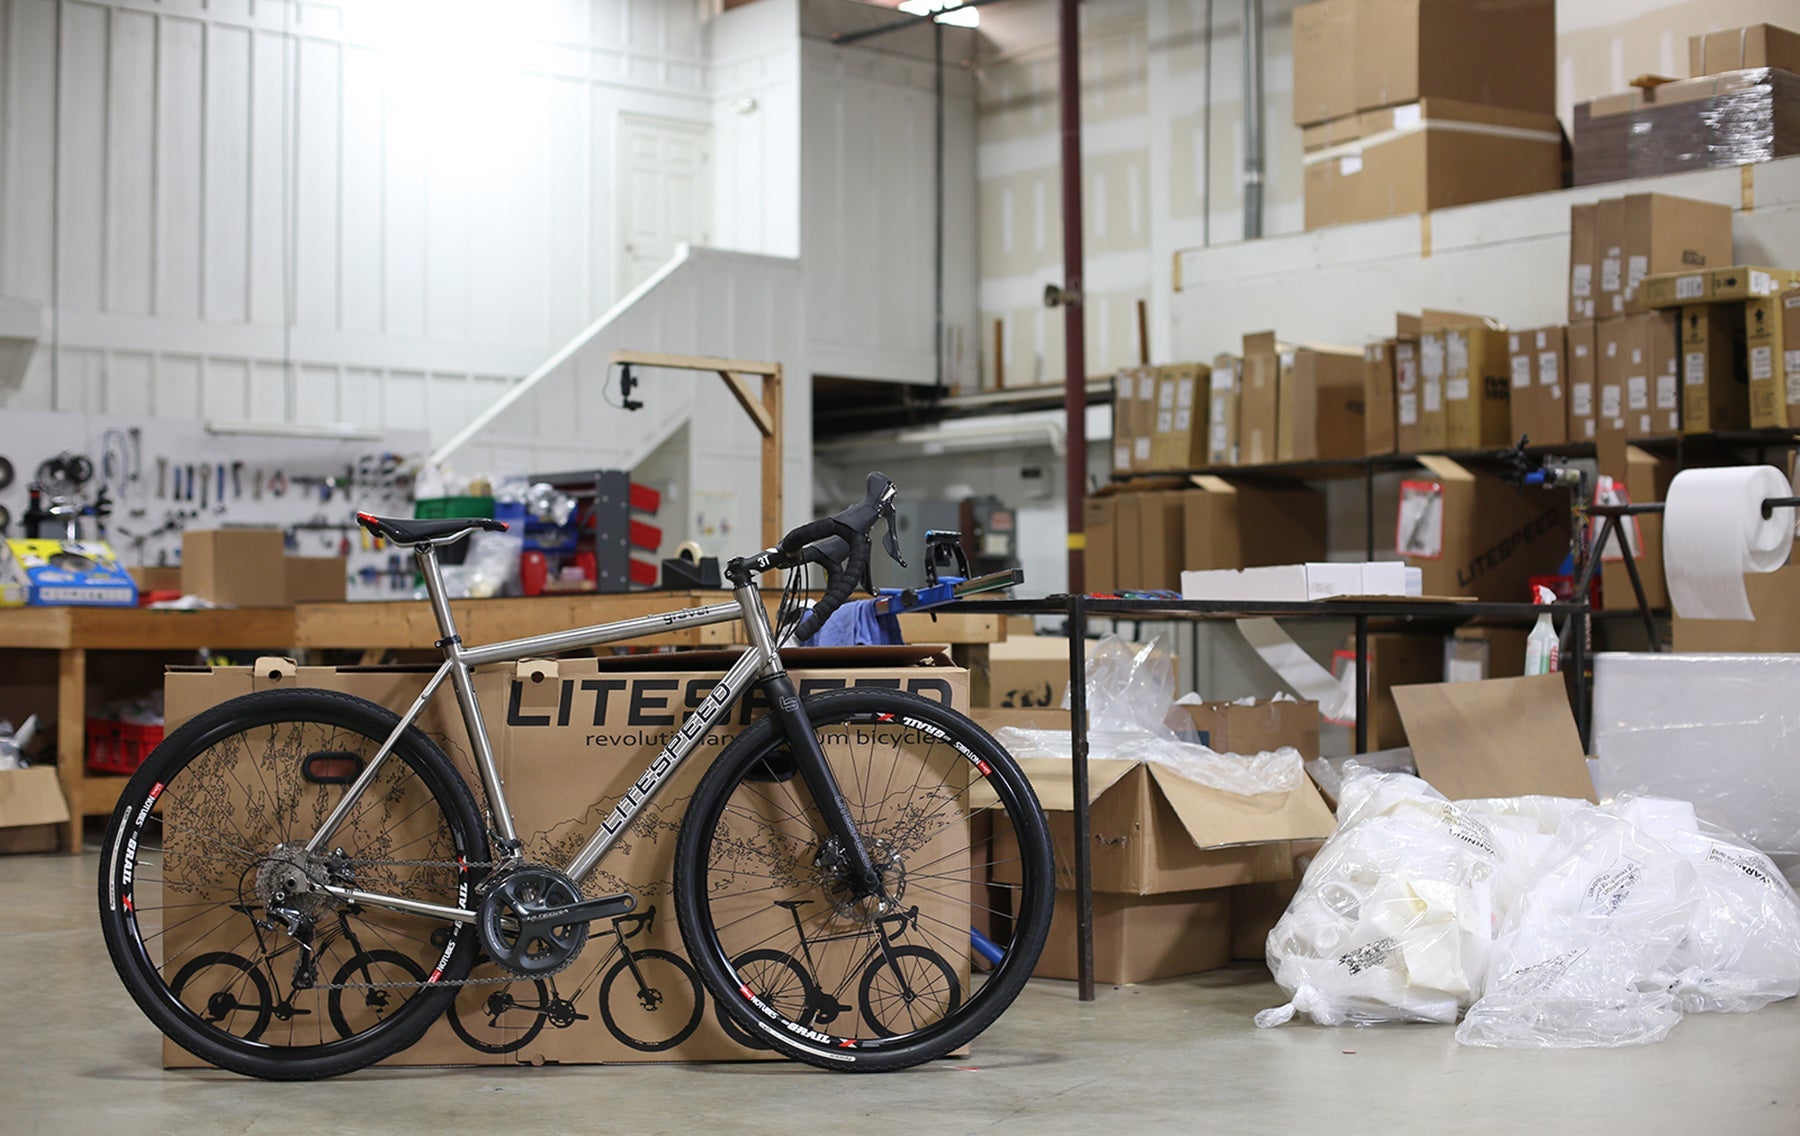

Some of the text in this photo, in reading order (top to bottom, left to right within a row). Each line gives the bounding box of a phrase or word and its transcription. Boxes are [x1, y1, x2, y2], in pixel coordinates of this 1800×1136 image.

[757, 554, 773, 568] 3T
[903, 716, 946, 739] GRAIL
[601, 682, 731, 835] LITESPEED
[121, 837, 138, 886] GRAIL
[750, 995, 779, 1020] NOTUBES
[786, 1021, 831, 1045] GRAIL
